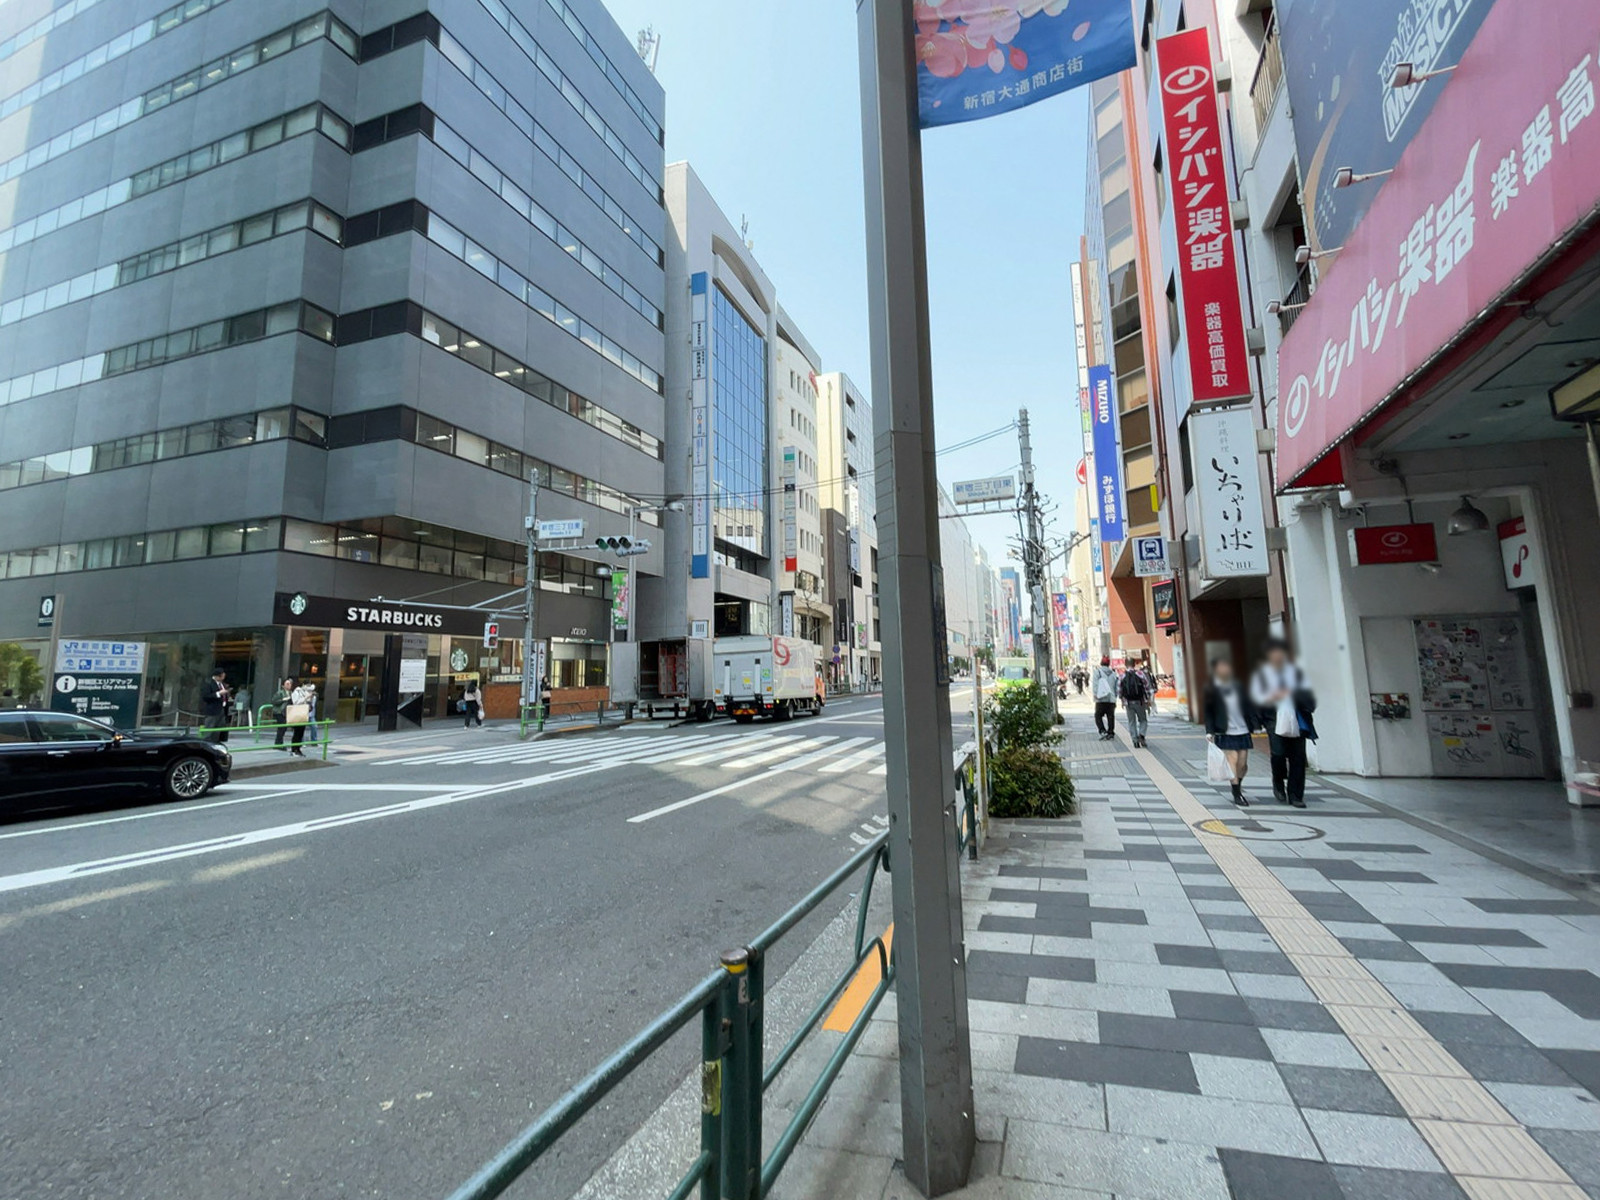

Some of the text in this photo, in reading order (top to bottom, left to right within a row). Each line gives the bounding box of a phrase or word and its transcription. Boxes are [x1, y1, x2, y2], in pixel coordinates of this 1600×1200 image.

[963, 55, 1084, 110] 新宿大通商店街
[1172, 95, 1229, 272] イシバシ楽器
[1312, 36, 1600, 400] イシバシ楽器 楽器高
[1203, 302, 1229, 388] 楽器高価買取
[1096, 379, 1110, 424] MIZUHO
[1101, 474, 1117, 524] みずほ銀行
[1210, 455, 1254, 551] いちゃりば
[347, 607, 443, 628] STARBUCKS
